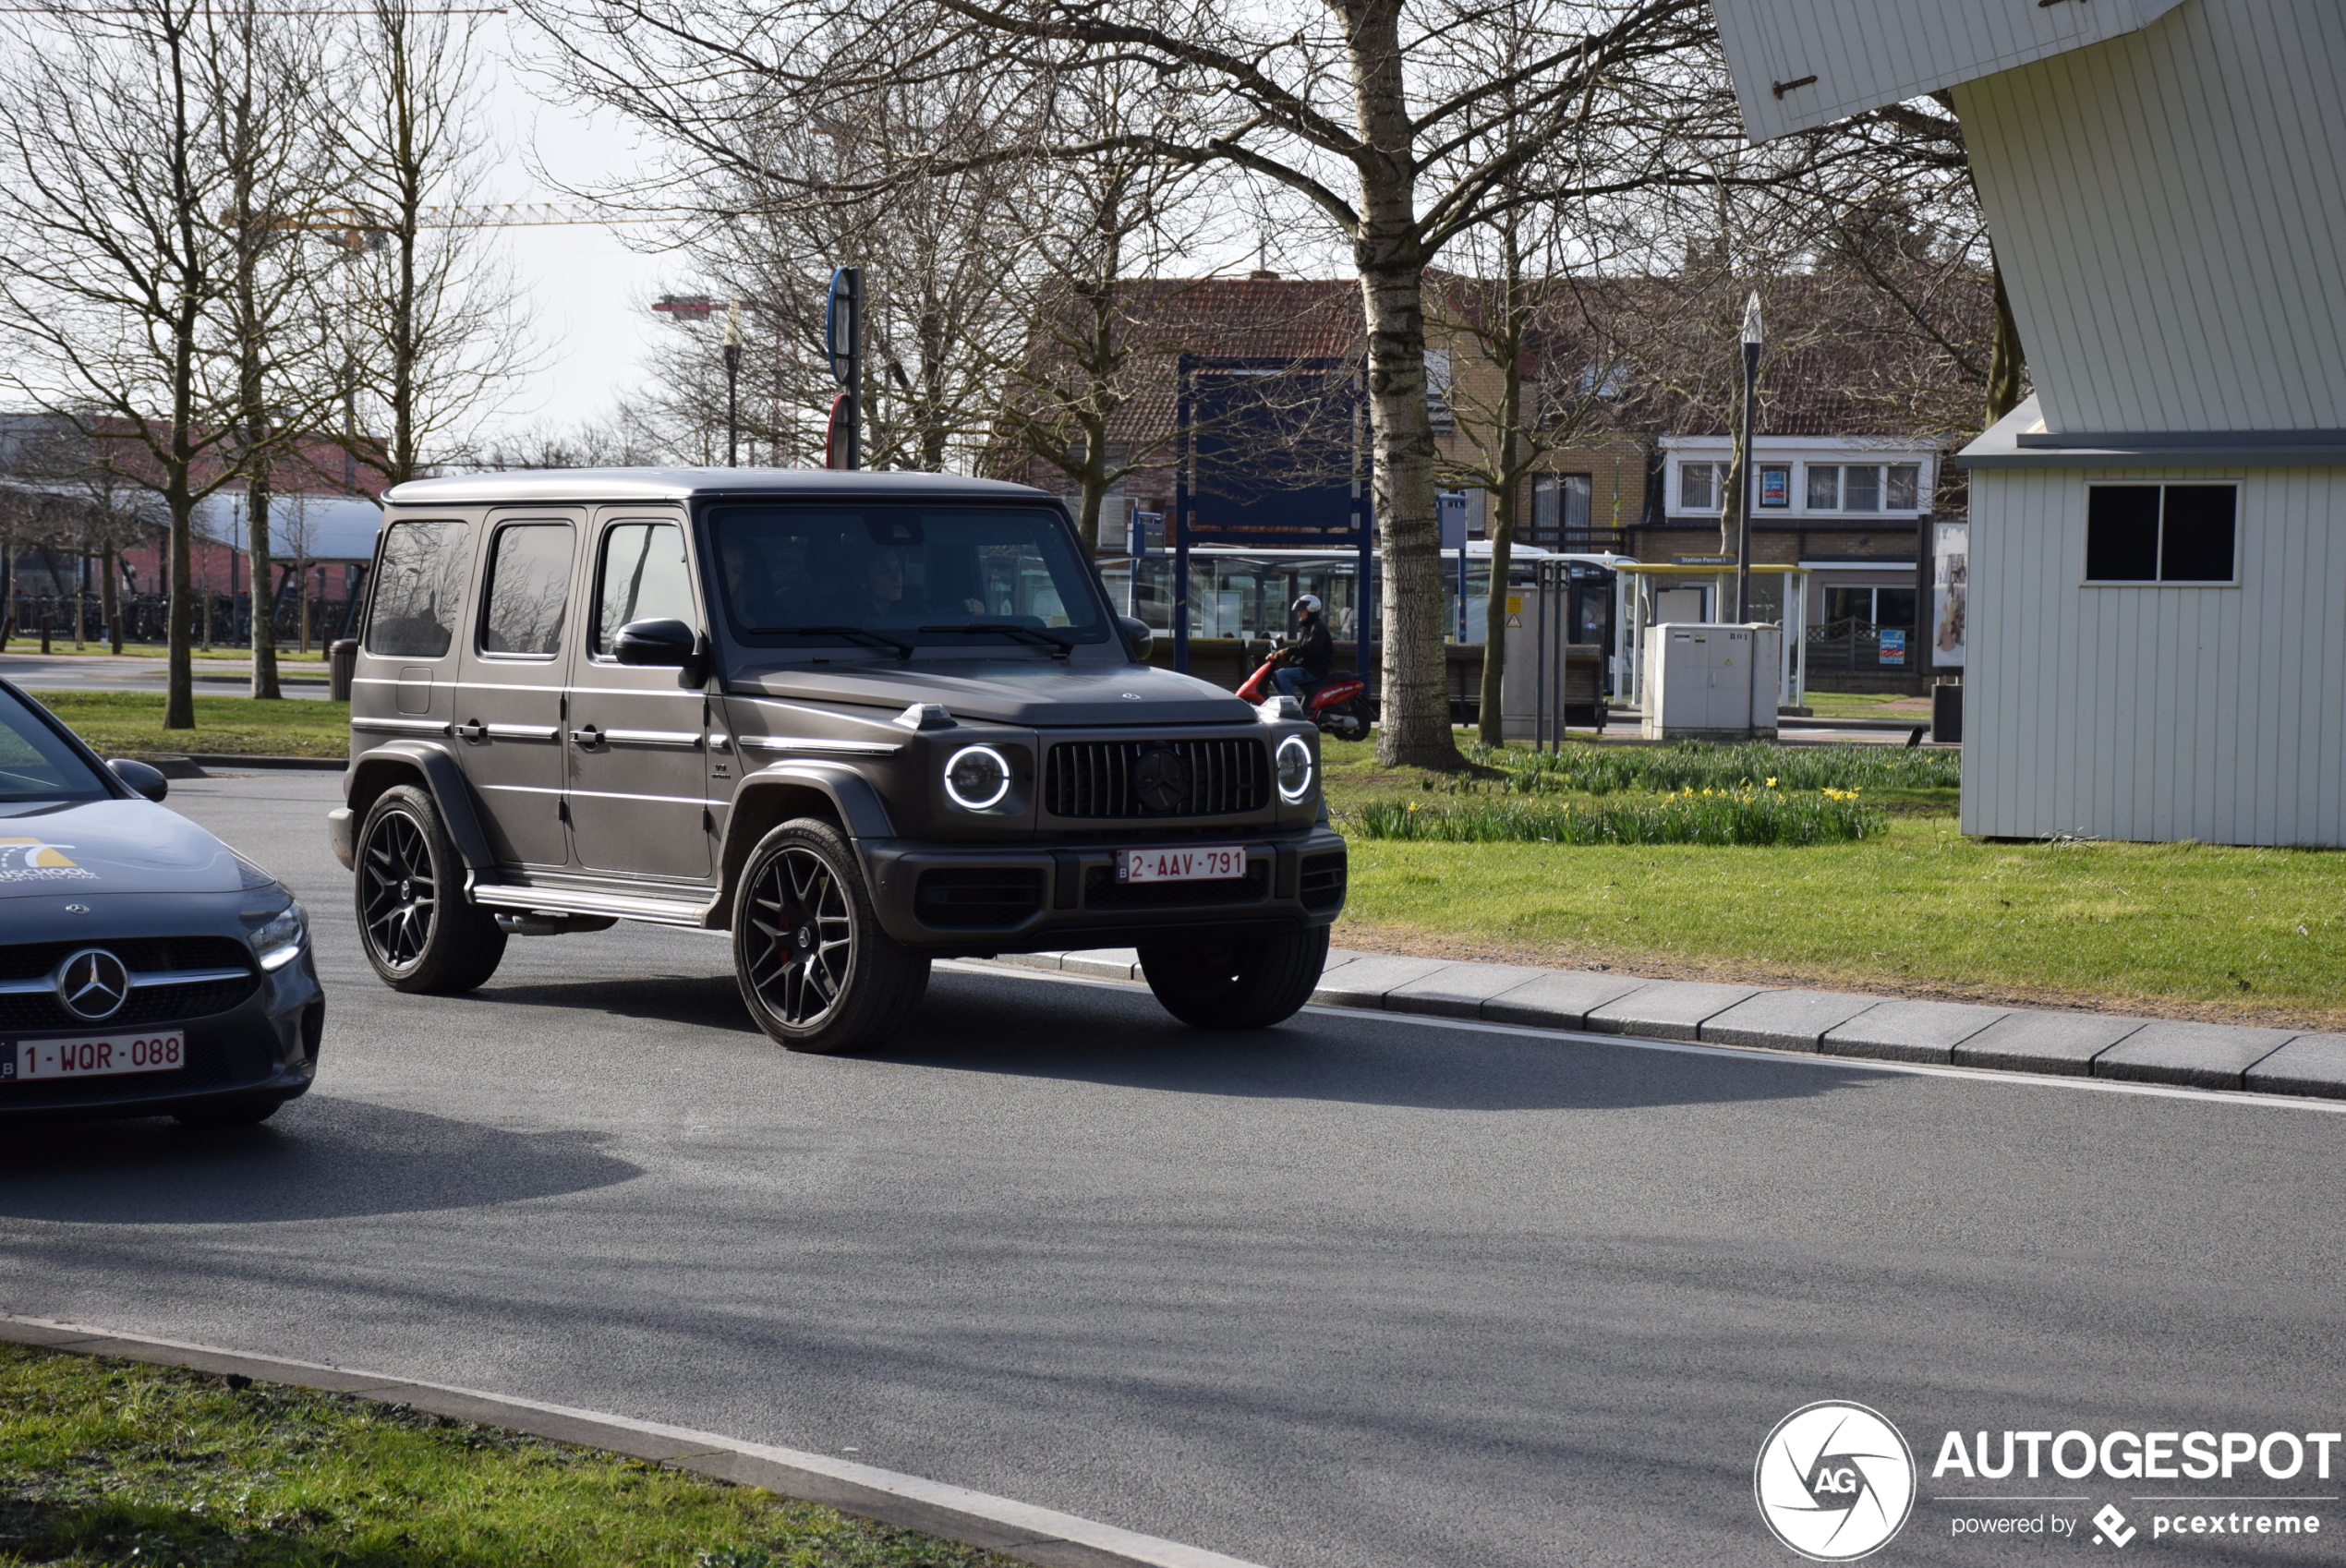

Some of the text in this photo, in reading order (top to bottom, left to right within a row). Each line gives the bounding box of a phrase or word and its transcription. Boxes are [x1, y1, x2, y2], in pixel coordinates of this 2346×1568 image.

[1119, 868, 1127, 878] B
[1131, 851, 1241, 877] 2-AAV-791
[25, 1037, 180, 1073] 1-WQR-088
[3, 1063, 14, 1076] B
